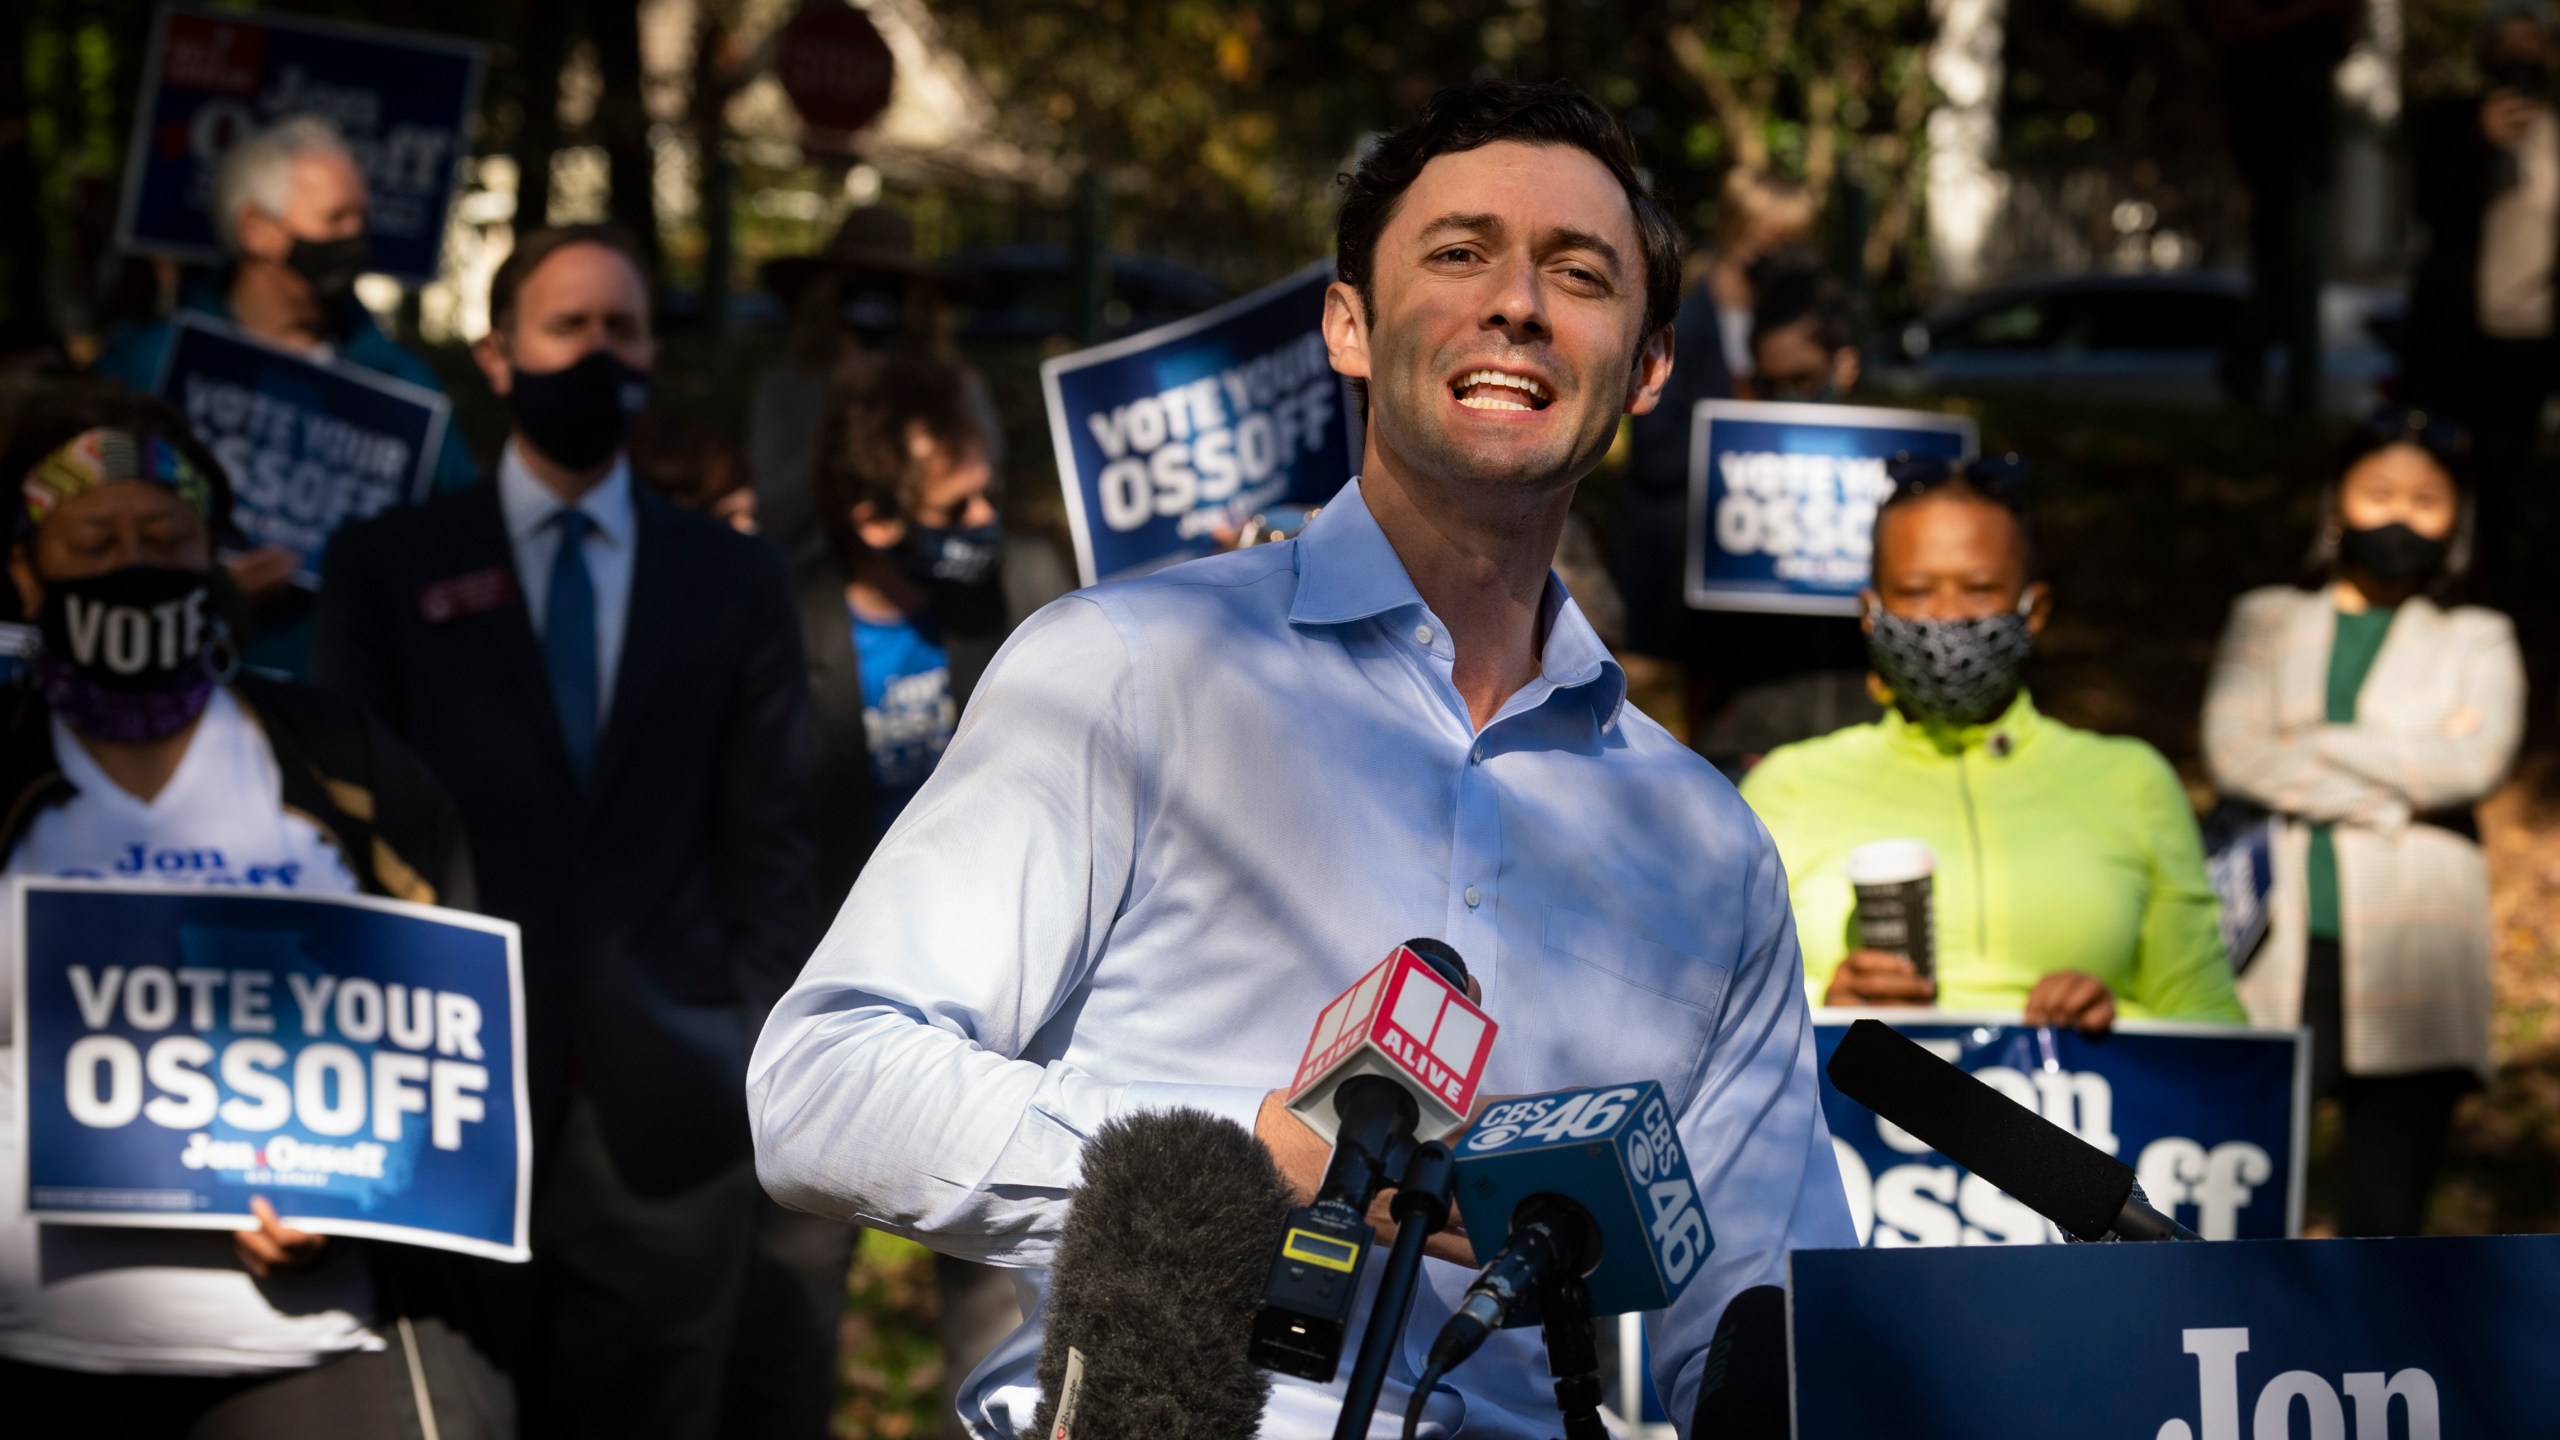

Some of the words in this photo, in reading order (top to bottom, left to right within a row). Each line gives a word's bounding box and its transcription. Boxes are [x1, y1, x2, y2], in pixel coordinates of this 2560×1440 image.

[188, 371, 298, 448] VOTE
[1087, 379, 1227, 458] VOTE
[1098, 380, 1336, 532] OSSOFF
[1718, 450, 1837, 500] VOTE
[63, 585, 210, 677] VOTE
[115, 844, 226, 882] Jon
[66, 965, 277, 1032] VOTE
[285, 972, 486, 1060] YOUR
[64, 1033, 490, 1152] OSSOFF
[1296, 1023, 1366, 1091] ALIVE
[1381, 1027, 1463, 1104] ALIVE
[181, 1132, 256, 1171] Jon
[1480, 1098, 1556, 1128] CBS
[1520, 1088, 1639, 1142] 46
[1643, 1098, 1680, 1177] CBS
[1648, 1178, 1706, 1285] 46
[2155, 1327, 2442, 1440] Jon
